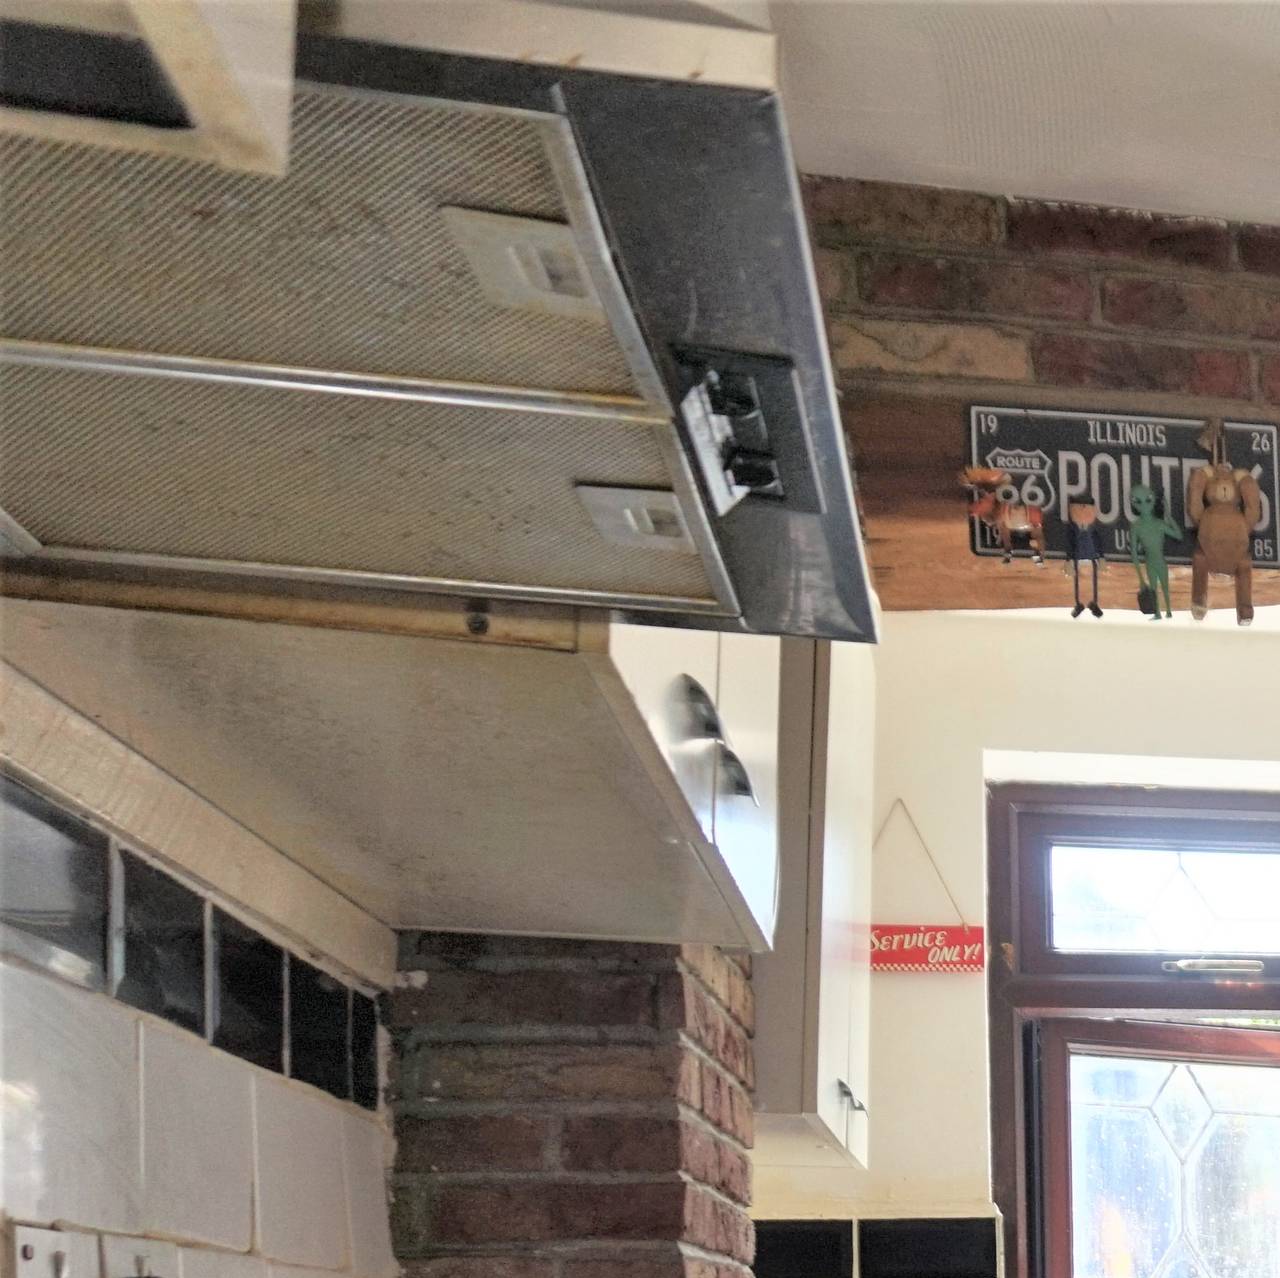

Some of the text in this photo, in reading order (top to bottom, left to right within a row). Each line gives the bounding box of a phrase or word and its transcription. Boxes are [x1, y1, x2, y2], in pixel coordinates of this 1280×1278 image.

[979, 413, 998, 434] 19
[1087, 420, 1168, 447] ILLINOIS
[1251, 432, 1271, 452] 26
[996, 454, 1041, 471] ROUTE
[1253, 539, 1274, 558] 85
[869, 926, 948, 952] Service
[927, 942, 982, 963] ONLY!
